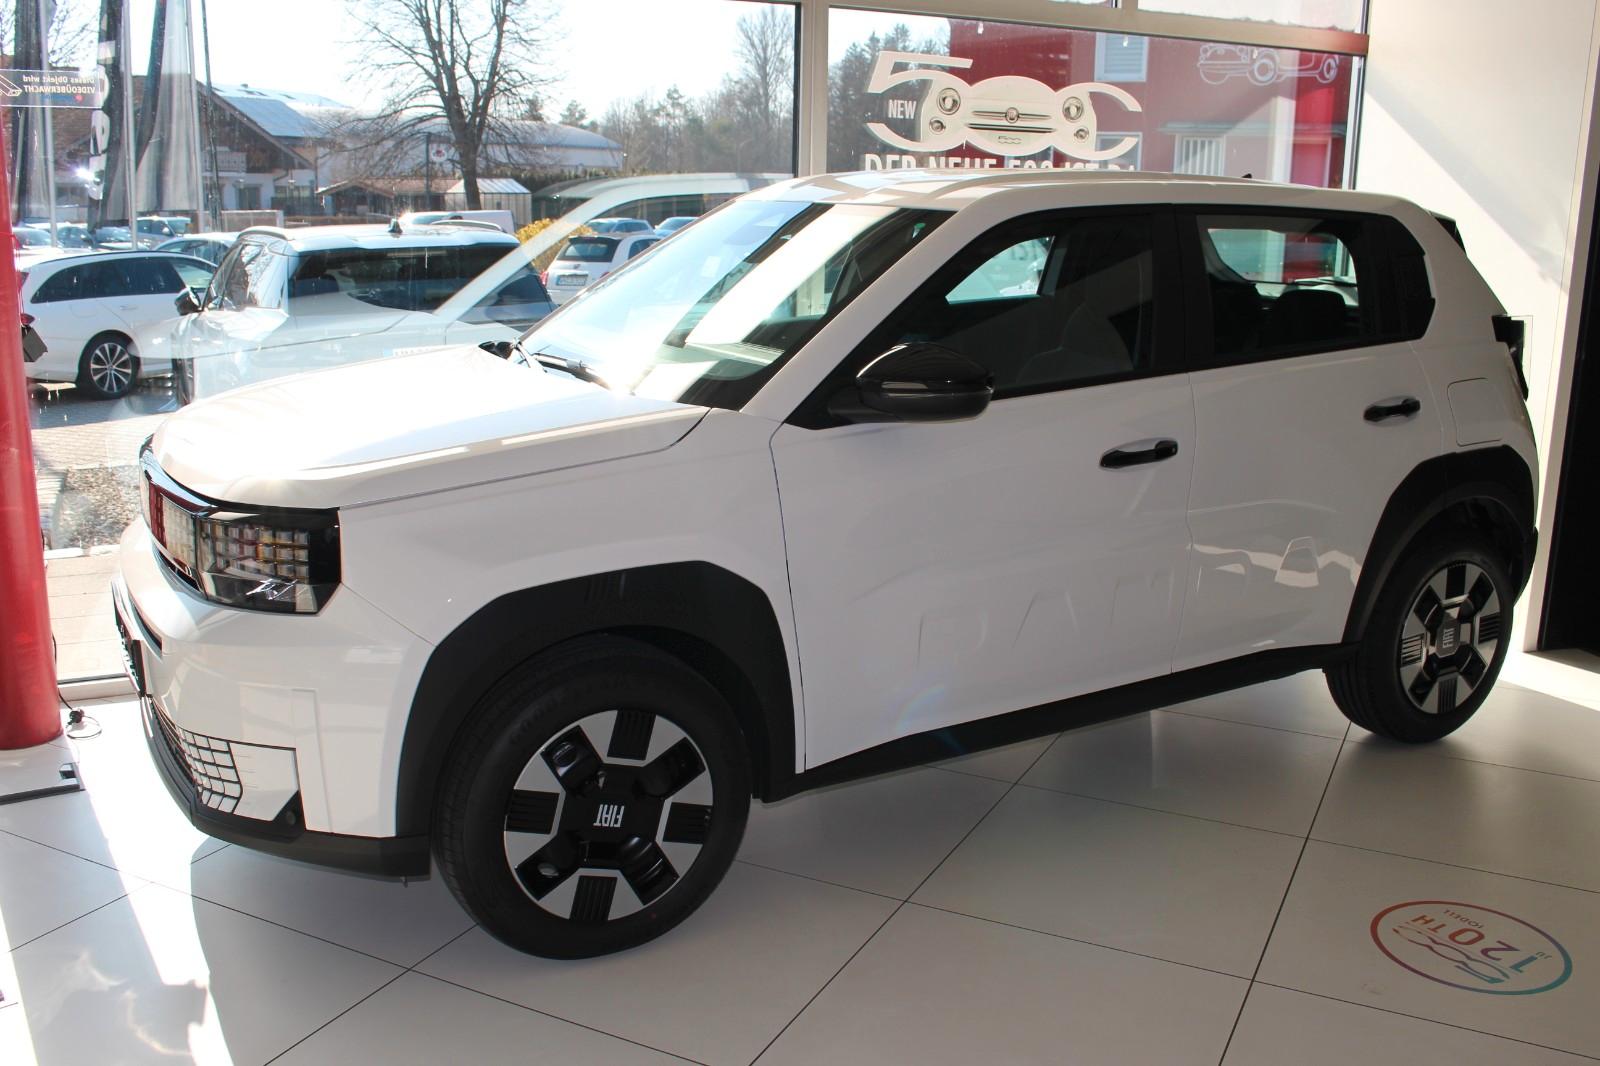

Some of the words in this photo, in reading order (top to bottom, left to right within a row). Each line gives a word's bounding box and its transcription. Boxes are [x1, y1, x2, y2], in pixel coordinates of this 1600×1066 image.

[887, 99, 917, 120] NEW
[1442, 627, 1455, 649] FIAT
[592, 803, 625, 828] FIAT
